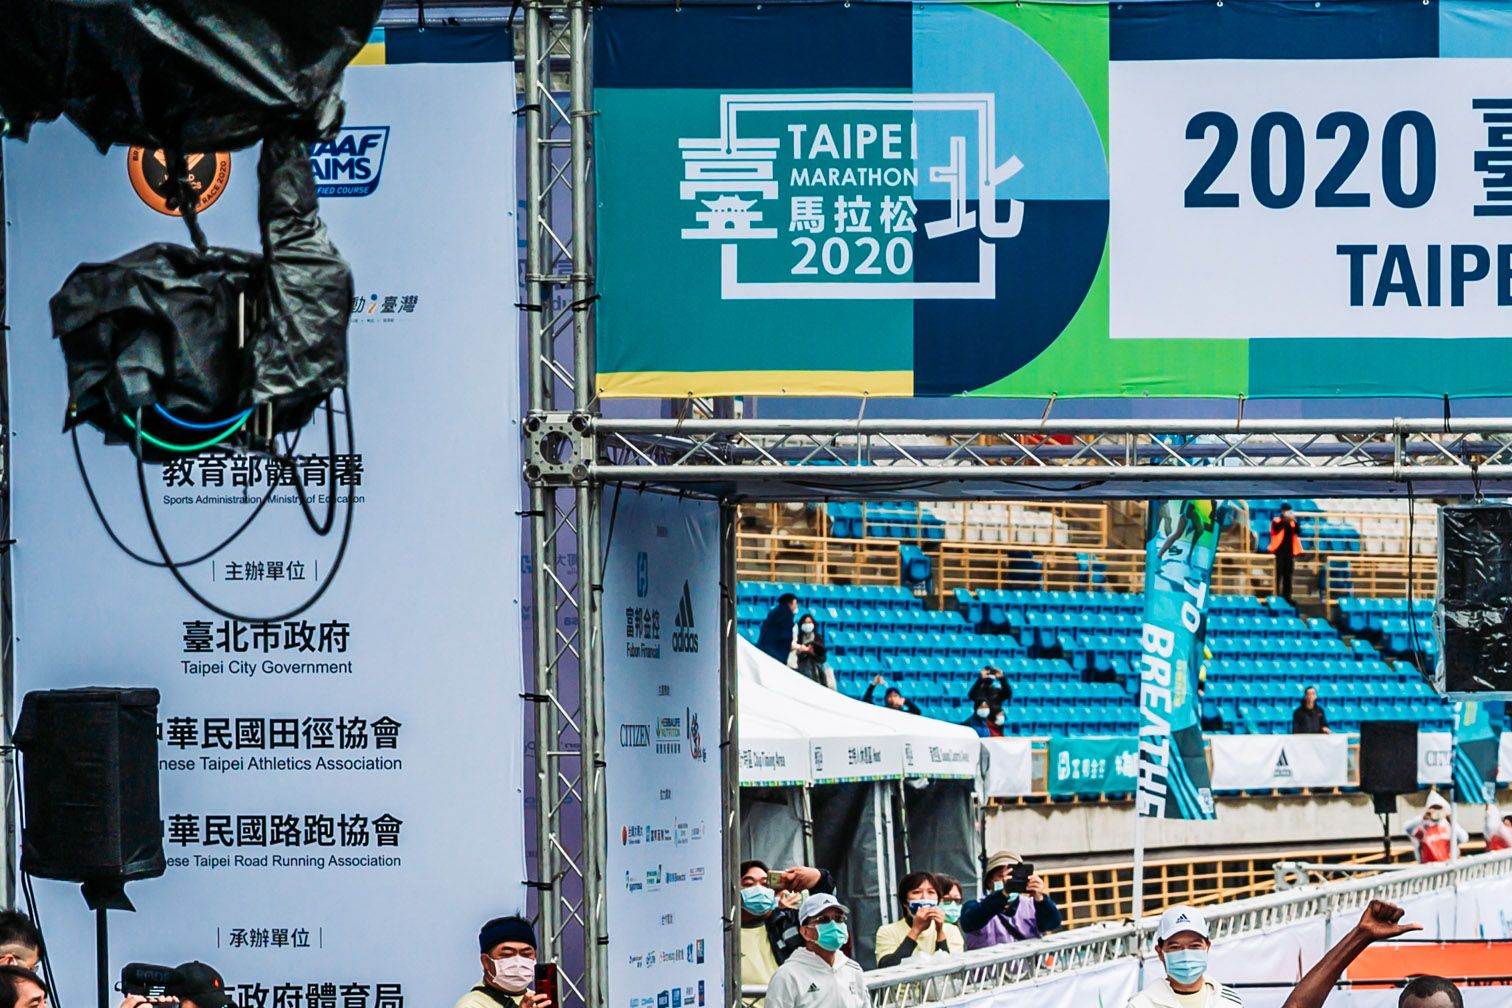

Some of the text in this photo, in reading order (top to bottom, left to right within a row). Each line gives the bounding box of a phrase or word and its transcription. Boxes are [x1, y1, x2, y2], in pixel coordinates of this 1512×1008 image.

[788, 117, 918, 160] TAIPEI
[1183, 110, 1437, 210] 2020
[789, 167, 918, 187] MARATHON
[336, 185, 370, 194] COURSE
[788, 195, 918, 234] 馬拉松
[790, 236, 914, 275] 2020
[163, 495, 194, 506] Sports
[307, 494, 316, 504] of
[225, 560, 306, 582] 主辦單位
[1181, 576, 1207, 634] TO
[182, 620, 350, 654] 臺北市政府
[672, 626, 698, 653] adidas
[181, 660, 353, 677] Taipei City Government
[620, 723, 651, 747] CITIZEN
[159, 756, 403, 774] nese Taipei Athletics Association
[160, 813, 404, 848] 華民國路跑協會
[193, 855, 231, 870] Taipei
[234, 855, 269, 868] Road
[272, 855, 325, 870] Running
[328, 855, 401, 868] Association
[229, 928, 310, 949] 承辦單位
